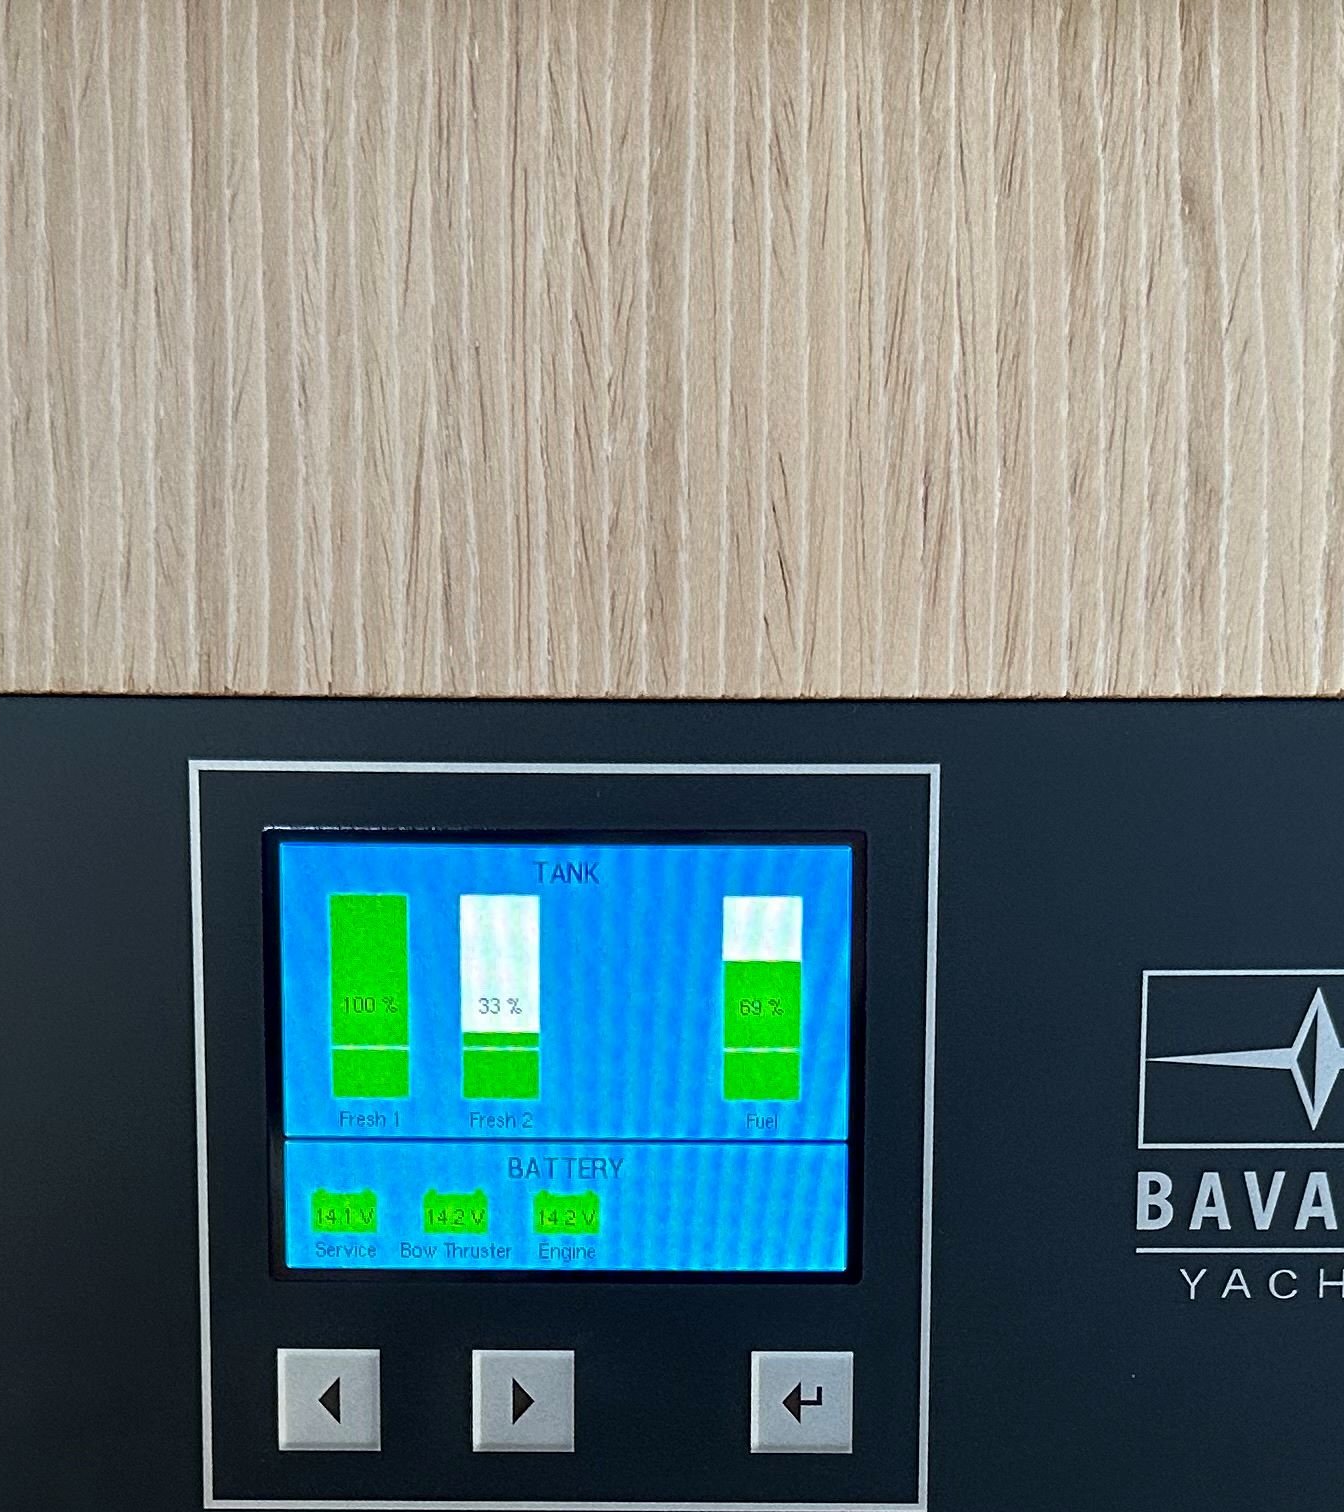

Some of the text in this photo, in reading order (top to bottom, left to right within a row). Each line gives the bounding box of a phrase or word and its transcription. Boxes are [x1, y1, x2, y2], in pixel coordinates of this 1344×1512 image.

[534, 861, 600, 884] TANK
[343, 996, 377, 1014] 100
[478, 998, 523, 1014] 33 %
[740, 998, 784, 1016] 69 %
[339, 1111, 400, 1128] Fresh 1
[470, 1112, 534, 1129] Fresh 2
[746, 1114, 779, 1130] Fuel
[509, 1158, 624, 1180] BATTERY
[428, 1209, 465, 1226] 142
[539, 1209, 576, 1226] 142
[315, 1241, 377, 1258] Service
[401, 1242, 512, 1259] Bow Thruster
[539, 1243, 596, 1261] Engine
